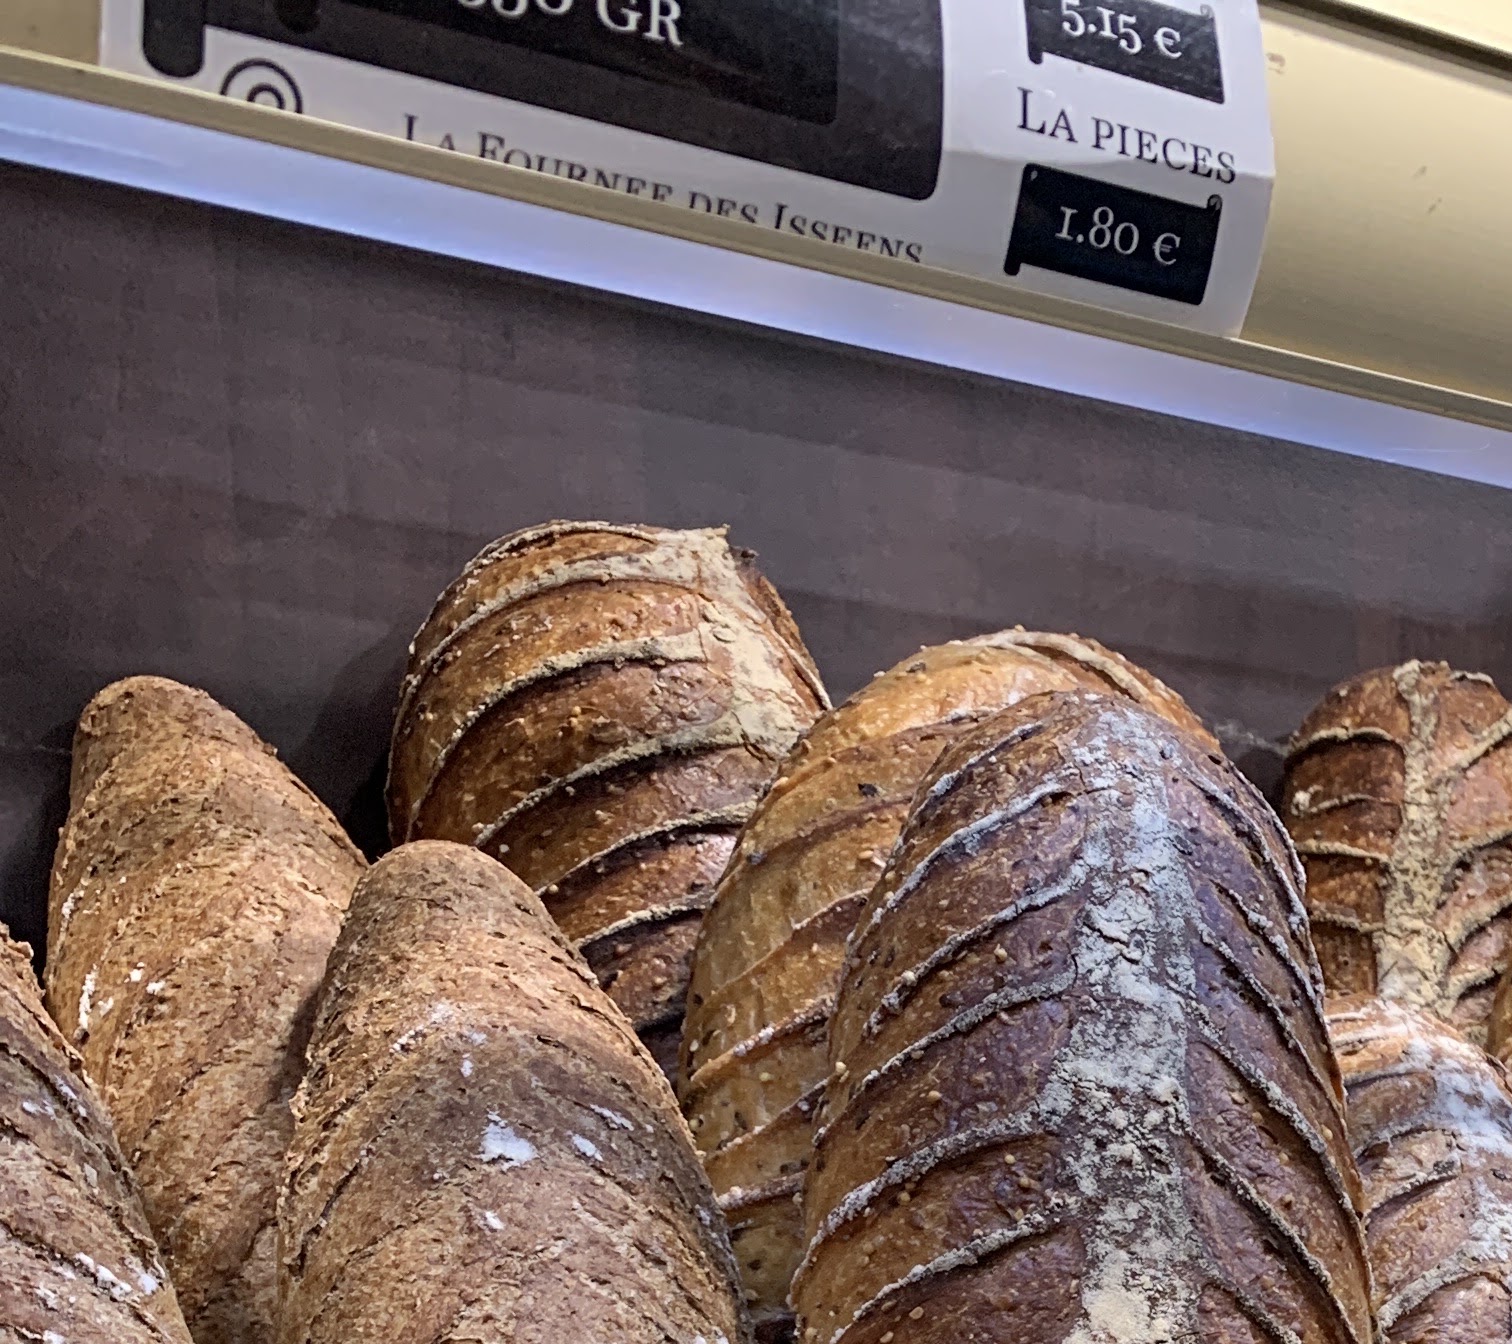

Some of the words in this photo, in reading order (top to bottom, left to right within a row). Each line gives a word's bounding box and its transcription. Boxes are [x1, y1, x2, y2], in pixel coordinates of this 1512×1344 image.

[596, 0, 683, 47] GR
[1061, 0, 1142, 54] 5.15
[1154, 26, 1183, 59] €
[1017, 86, 1079, 143] LA
[1091, 116, 1236, 184] PIECES
[1055, 205, 1140, 256] 1.80
[1152, 231, 1182, 266] €
